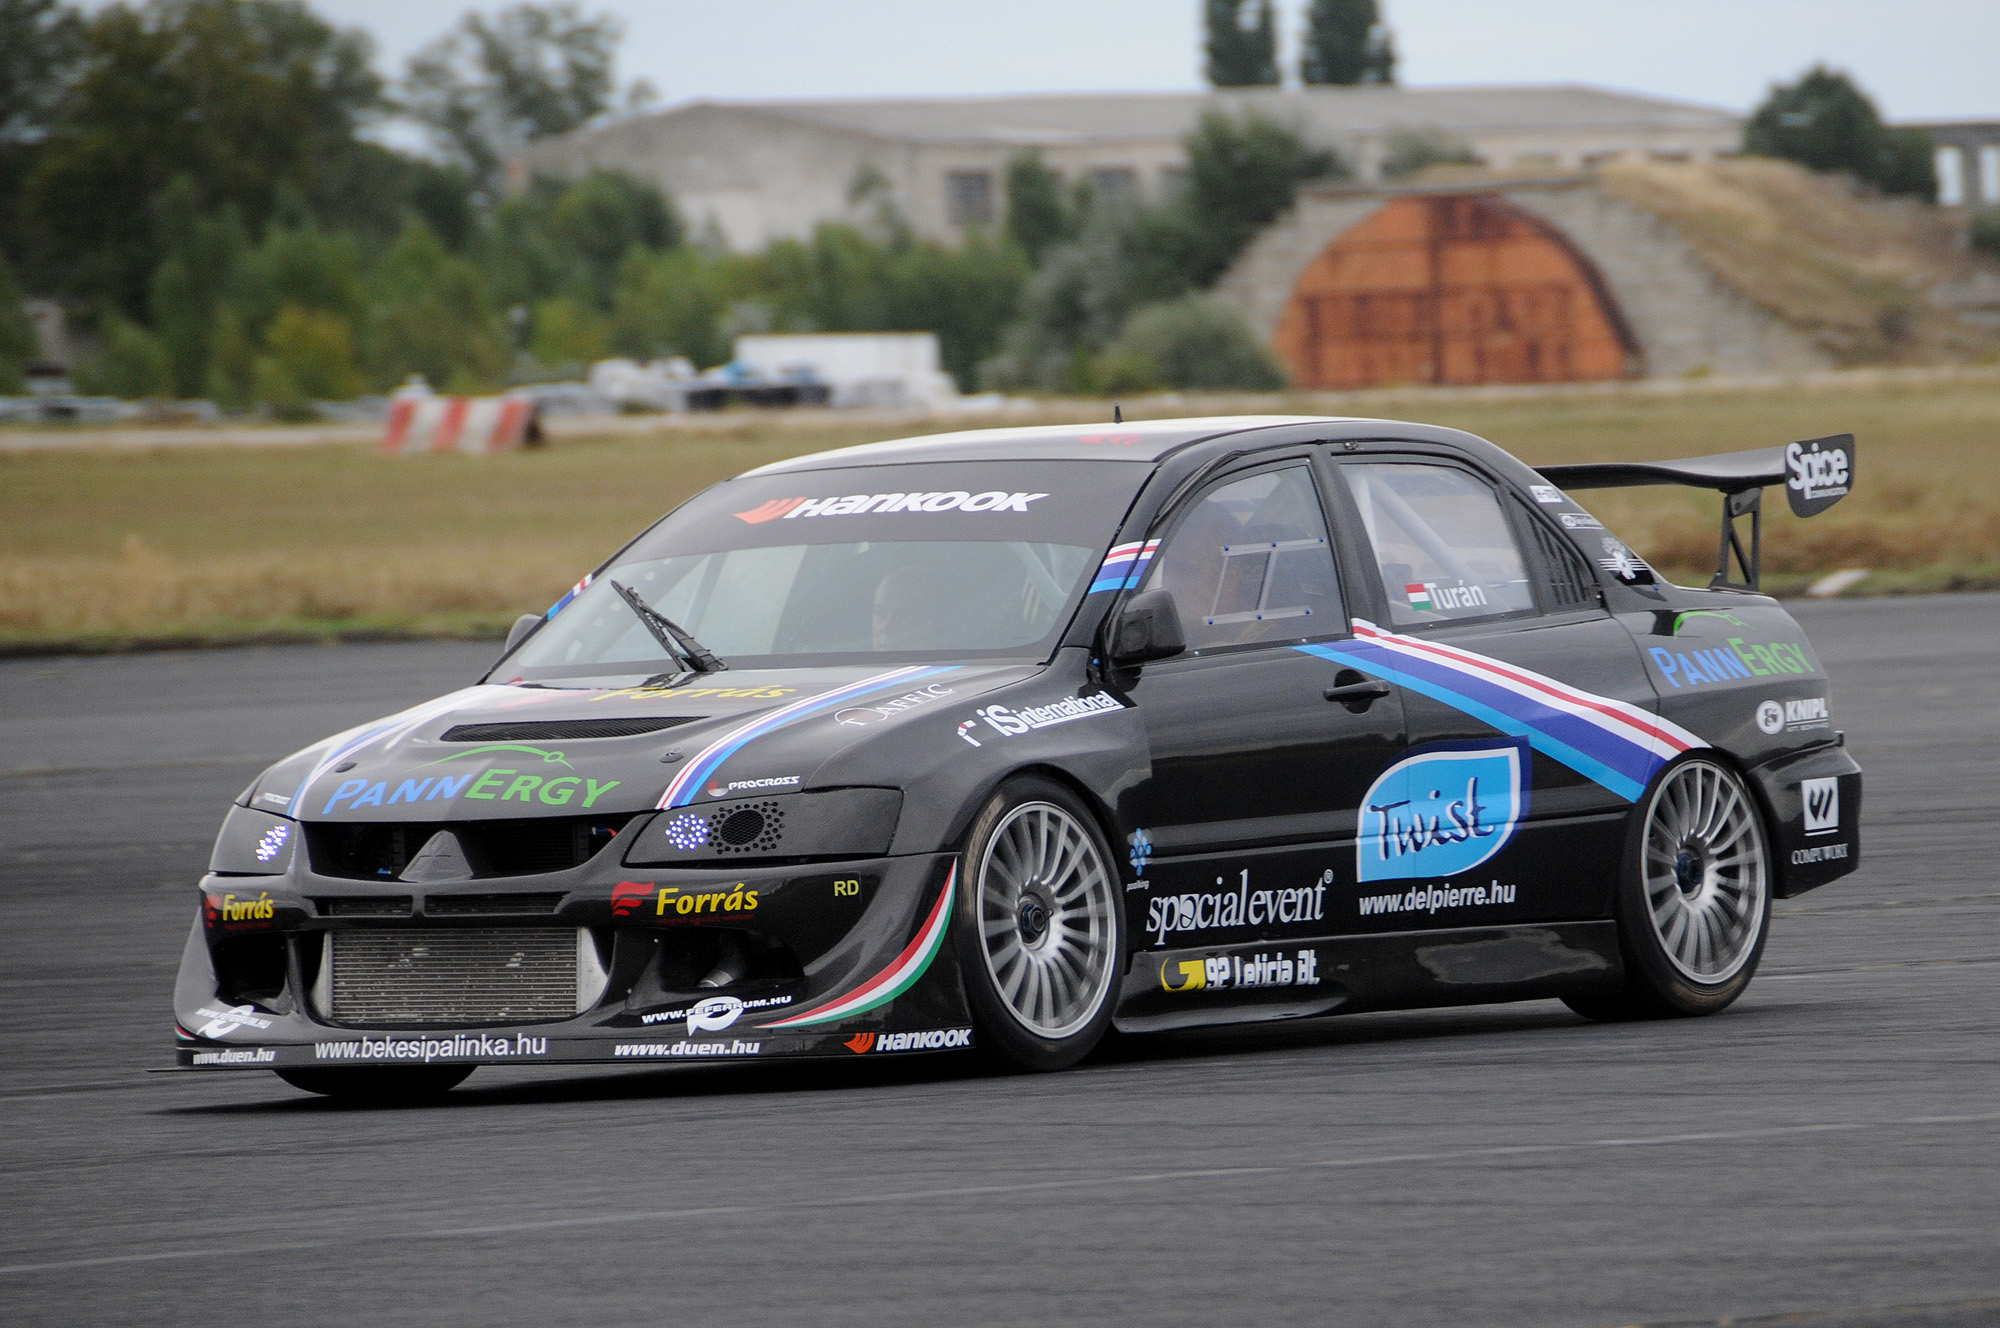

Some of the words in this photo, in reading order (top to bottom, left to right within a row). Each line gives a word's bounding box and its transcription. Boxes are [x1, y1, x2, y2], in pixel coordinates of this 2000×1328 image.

[1786, 442, 1849, 499] Spice
[1424, 580, 1488, 609] Turán
[589, 684, 797, 701] Forrás
[728, 776, 800, 790] PROCROSS
[1366, 777, 1496, 861] Twist
[656, 883, 759, 916] Forrás
[834, 880, 859, 896] RD
[1359, 880, 1517, 915] www.delpierre.hu
[222, 892, 274, 921] Forrás
[193, 1047, 276, 1065] www.duen.hu
[315, 1034, 547, 1062] www.bekesipalinka.hu
[614, 1040, 760, 1056] www.duen.hu
